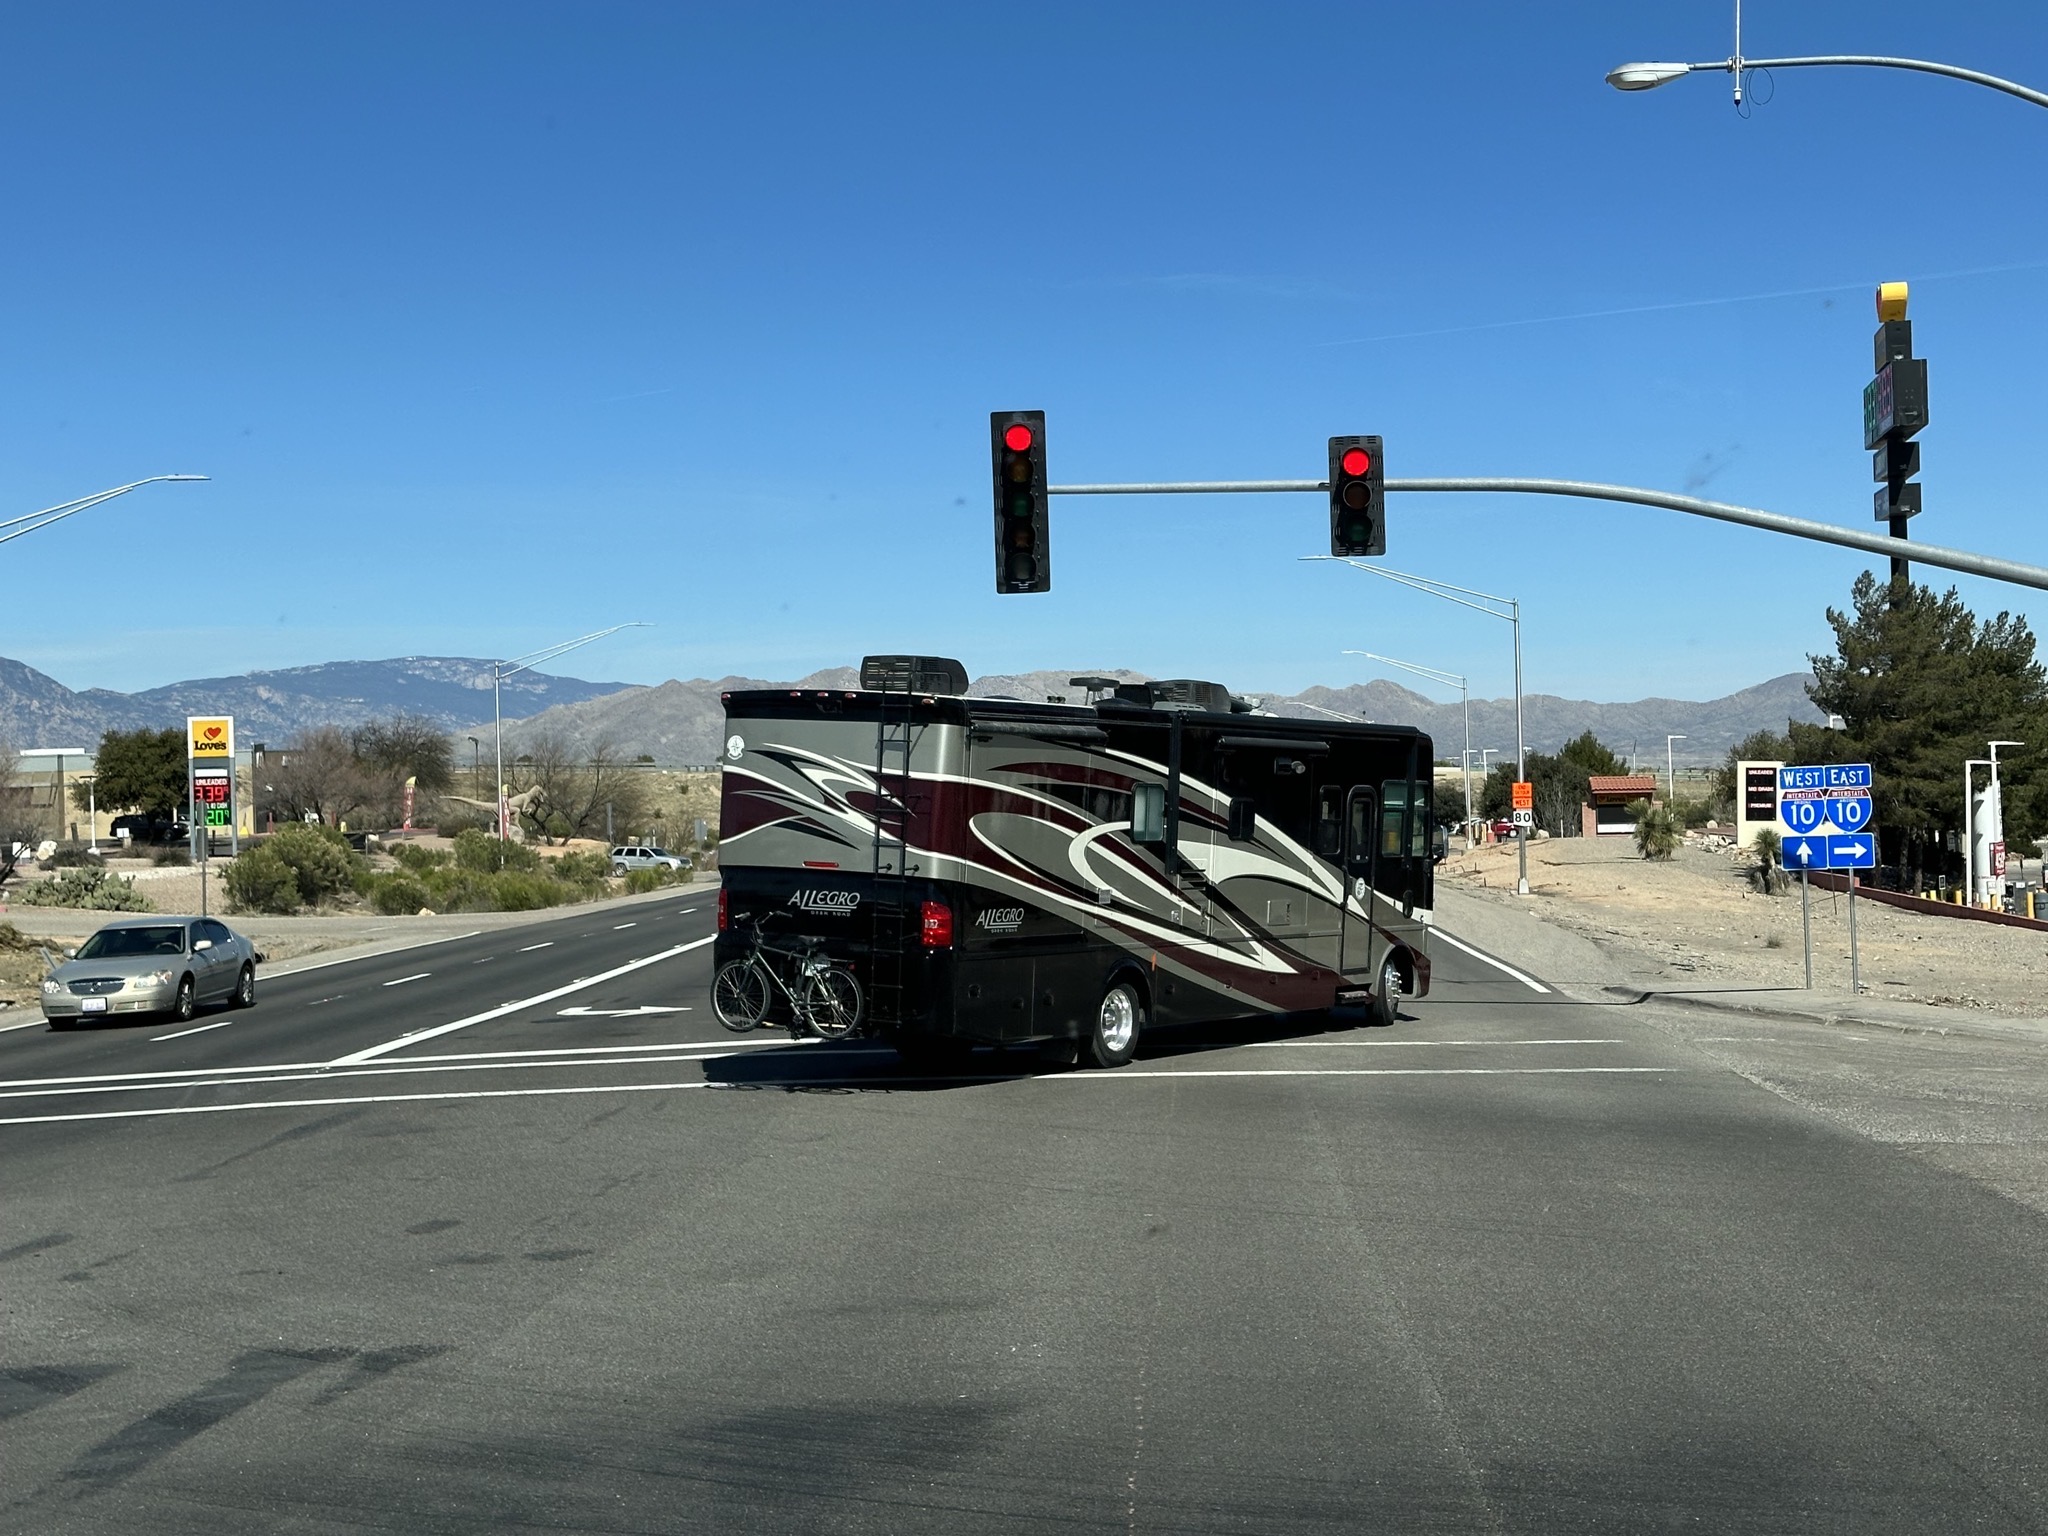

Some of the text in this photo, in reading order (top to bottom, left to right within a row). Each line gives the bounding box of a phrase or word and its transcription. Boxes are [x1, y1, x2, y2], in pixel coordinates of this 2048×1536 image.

[194, 740, 227, 751] Love's
[195, 778, 228, 786] UNLEADED
[1783, 771, 1820, 787] WEST
[1830, 769, 1864, 785] EAST
[1515, 812, 1531, 823] 80
[1790, 804, 1815, 825] 10
[1836, 802, 1861, 823] 10
[787, 889, 861, 912] ALLEGRO
[975, 907, 1025, 929] ALLEGRO
